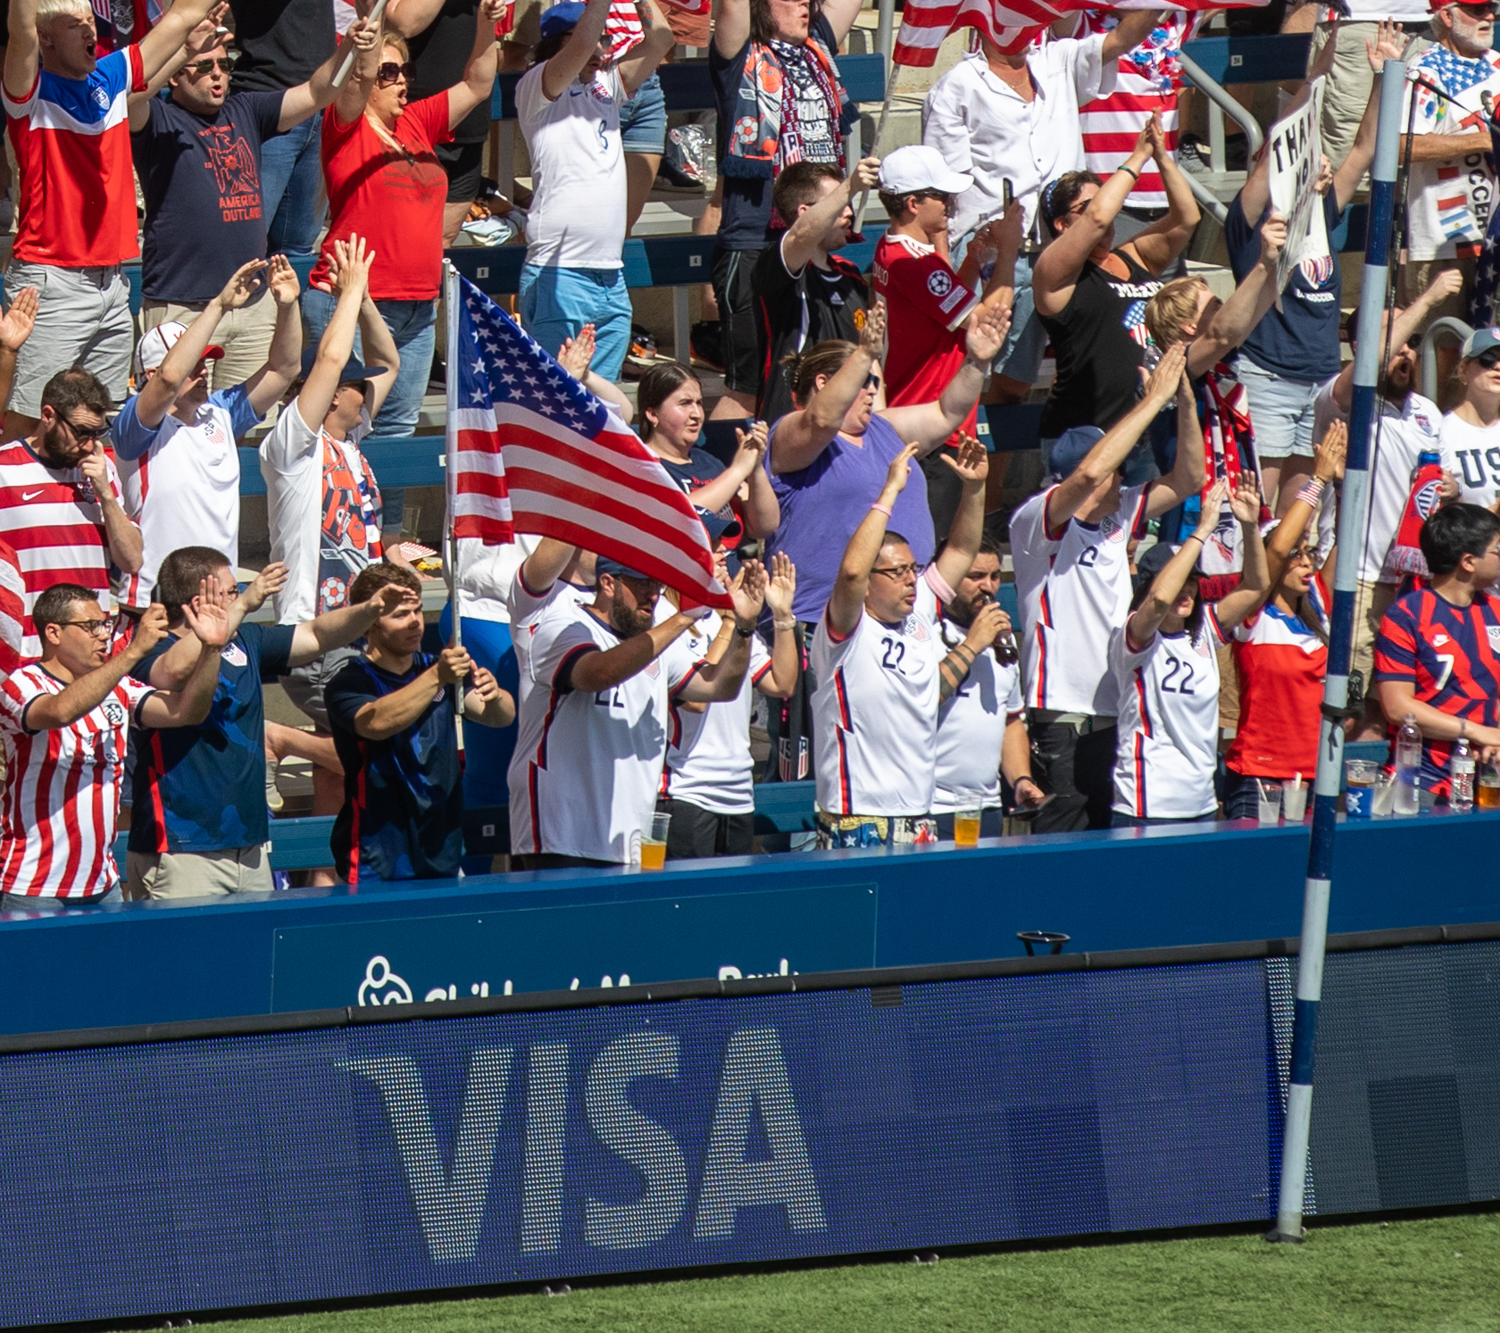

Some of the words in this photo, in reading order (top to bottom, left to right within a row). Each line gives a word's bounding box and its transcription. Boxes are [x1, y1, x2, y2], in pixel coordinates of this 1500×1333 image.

[880, 637, 906, 674] 22
[1435, 654, 1455, 691] 7
[1161, 656, 1195, 695] 22
[334, 1026, 829, 1266] VISA
